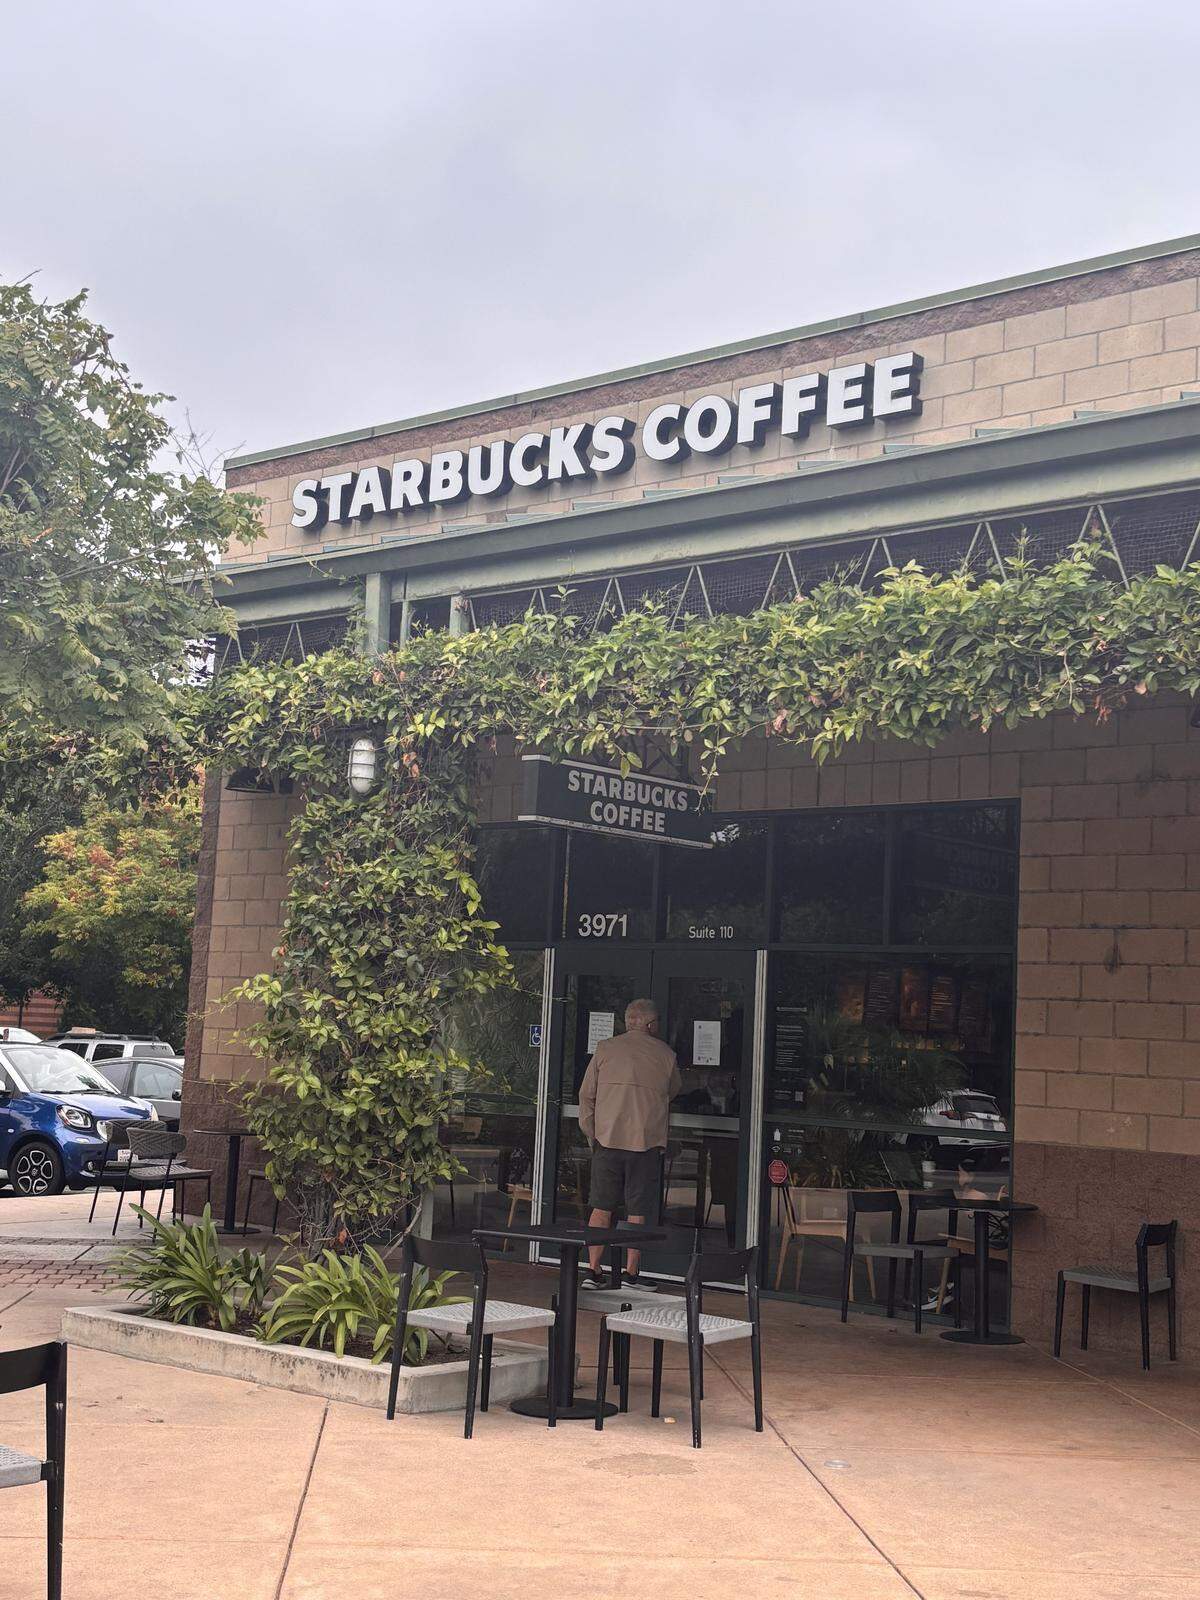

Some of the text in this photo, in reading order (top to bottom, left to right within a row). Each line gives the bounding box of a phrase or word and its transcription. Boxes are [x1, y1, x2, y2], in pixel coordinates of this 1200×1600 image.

[291, 351, 919, 529] STARBUCKS COFFEE
[568, 770, 688, 833] STARBUCKS COFFEE
[578, 913, 628, 937] 3971
[688, 926, 734, 939] Suite 110
